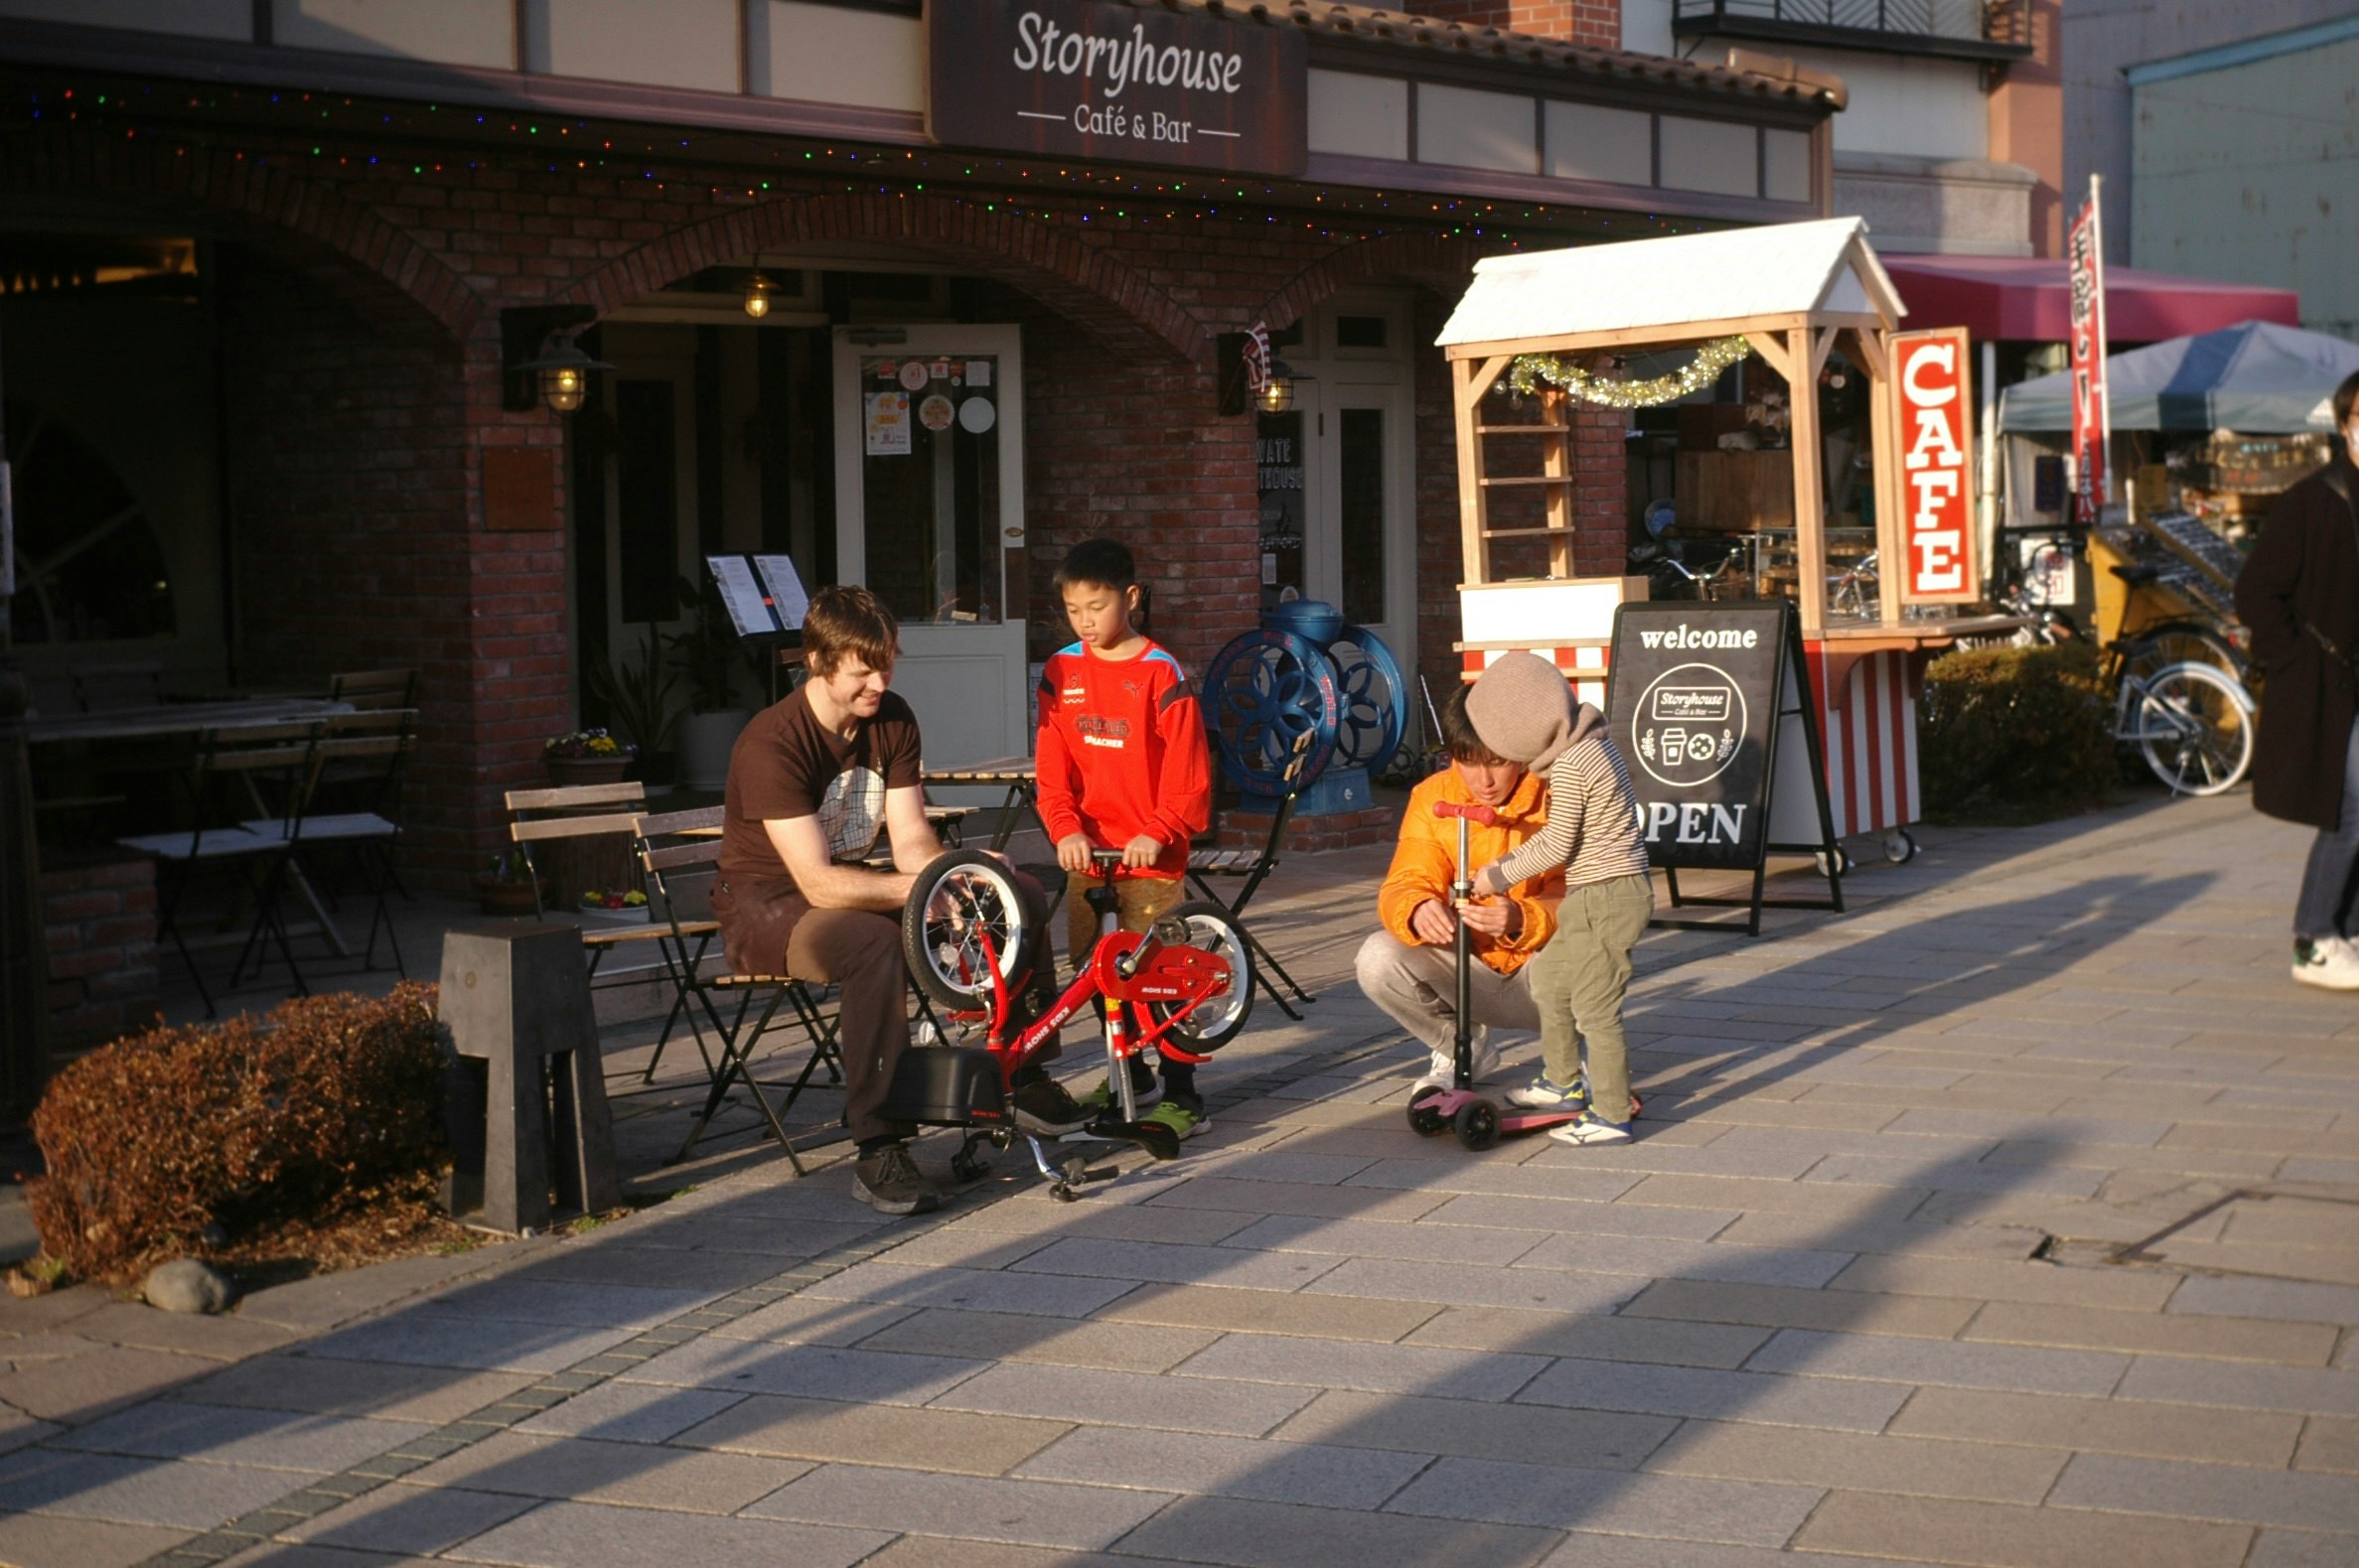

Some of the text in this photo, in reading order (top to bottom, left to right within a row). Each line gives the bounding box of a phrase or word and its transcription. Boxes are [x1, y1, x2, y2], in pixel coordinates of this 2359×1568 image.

[1013, 12, 1243, 98] Storyhouse
[1074, 103, 1193, 144] Café & Bar
[1255, 438, 1291, 463] VATE
[1903, 344, 1964, 591] CAFE
[1641, 624, 1758, 649] welcome
[1660, 691, 1724, 708] Storyhouse
[1636, 801, 1747, 845] PEN
[1024, 1006, 1071, 1054] KIDS SHOW
